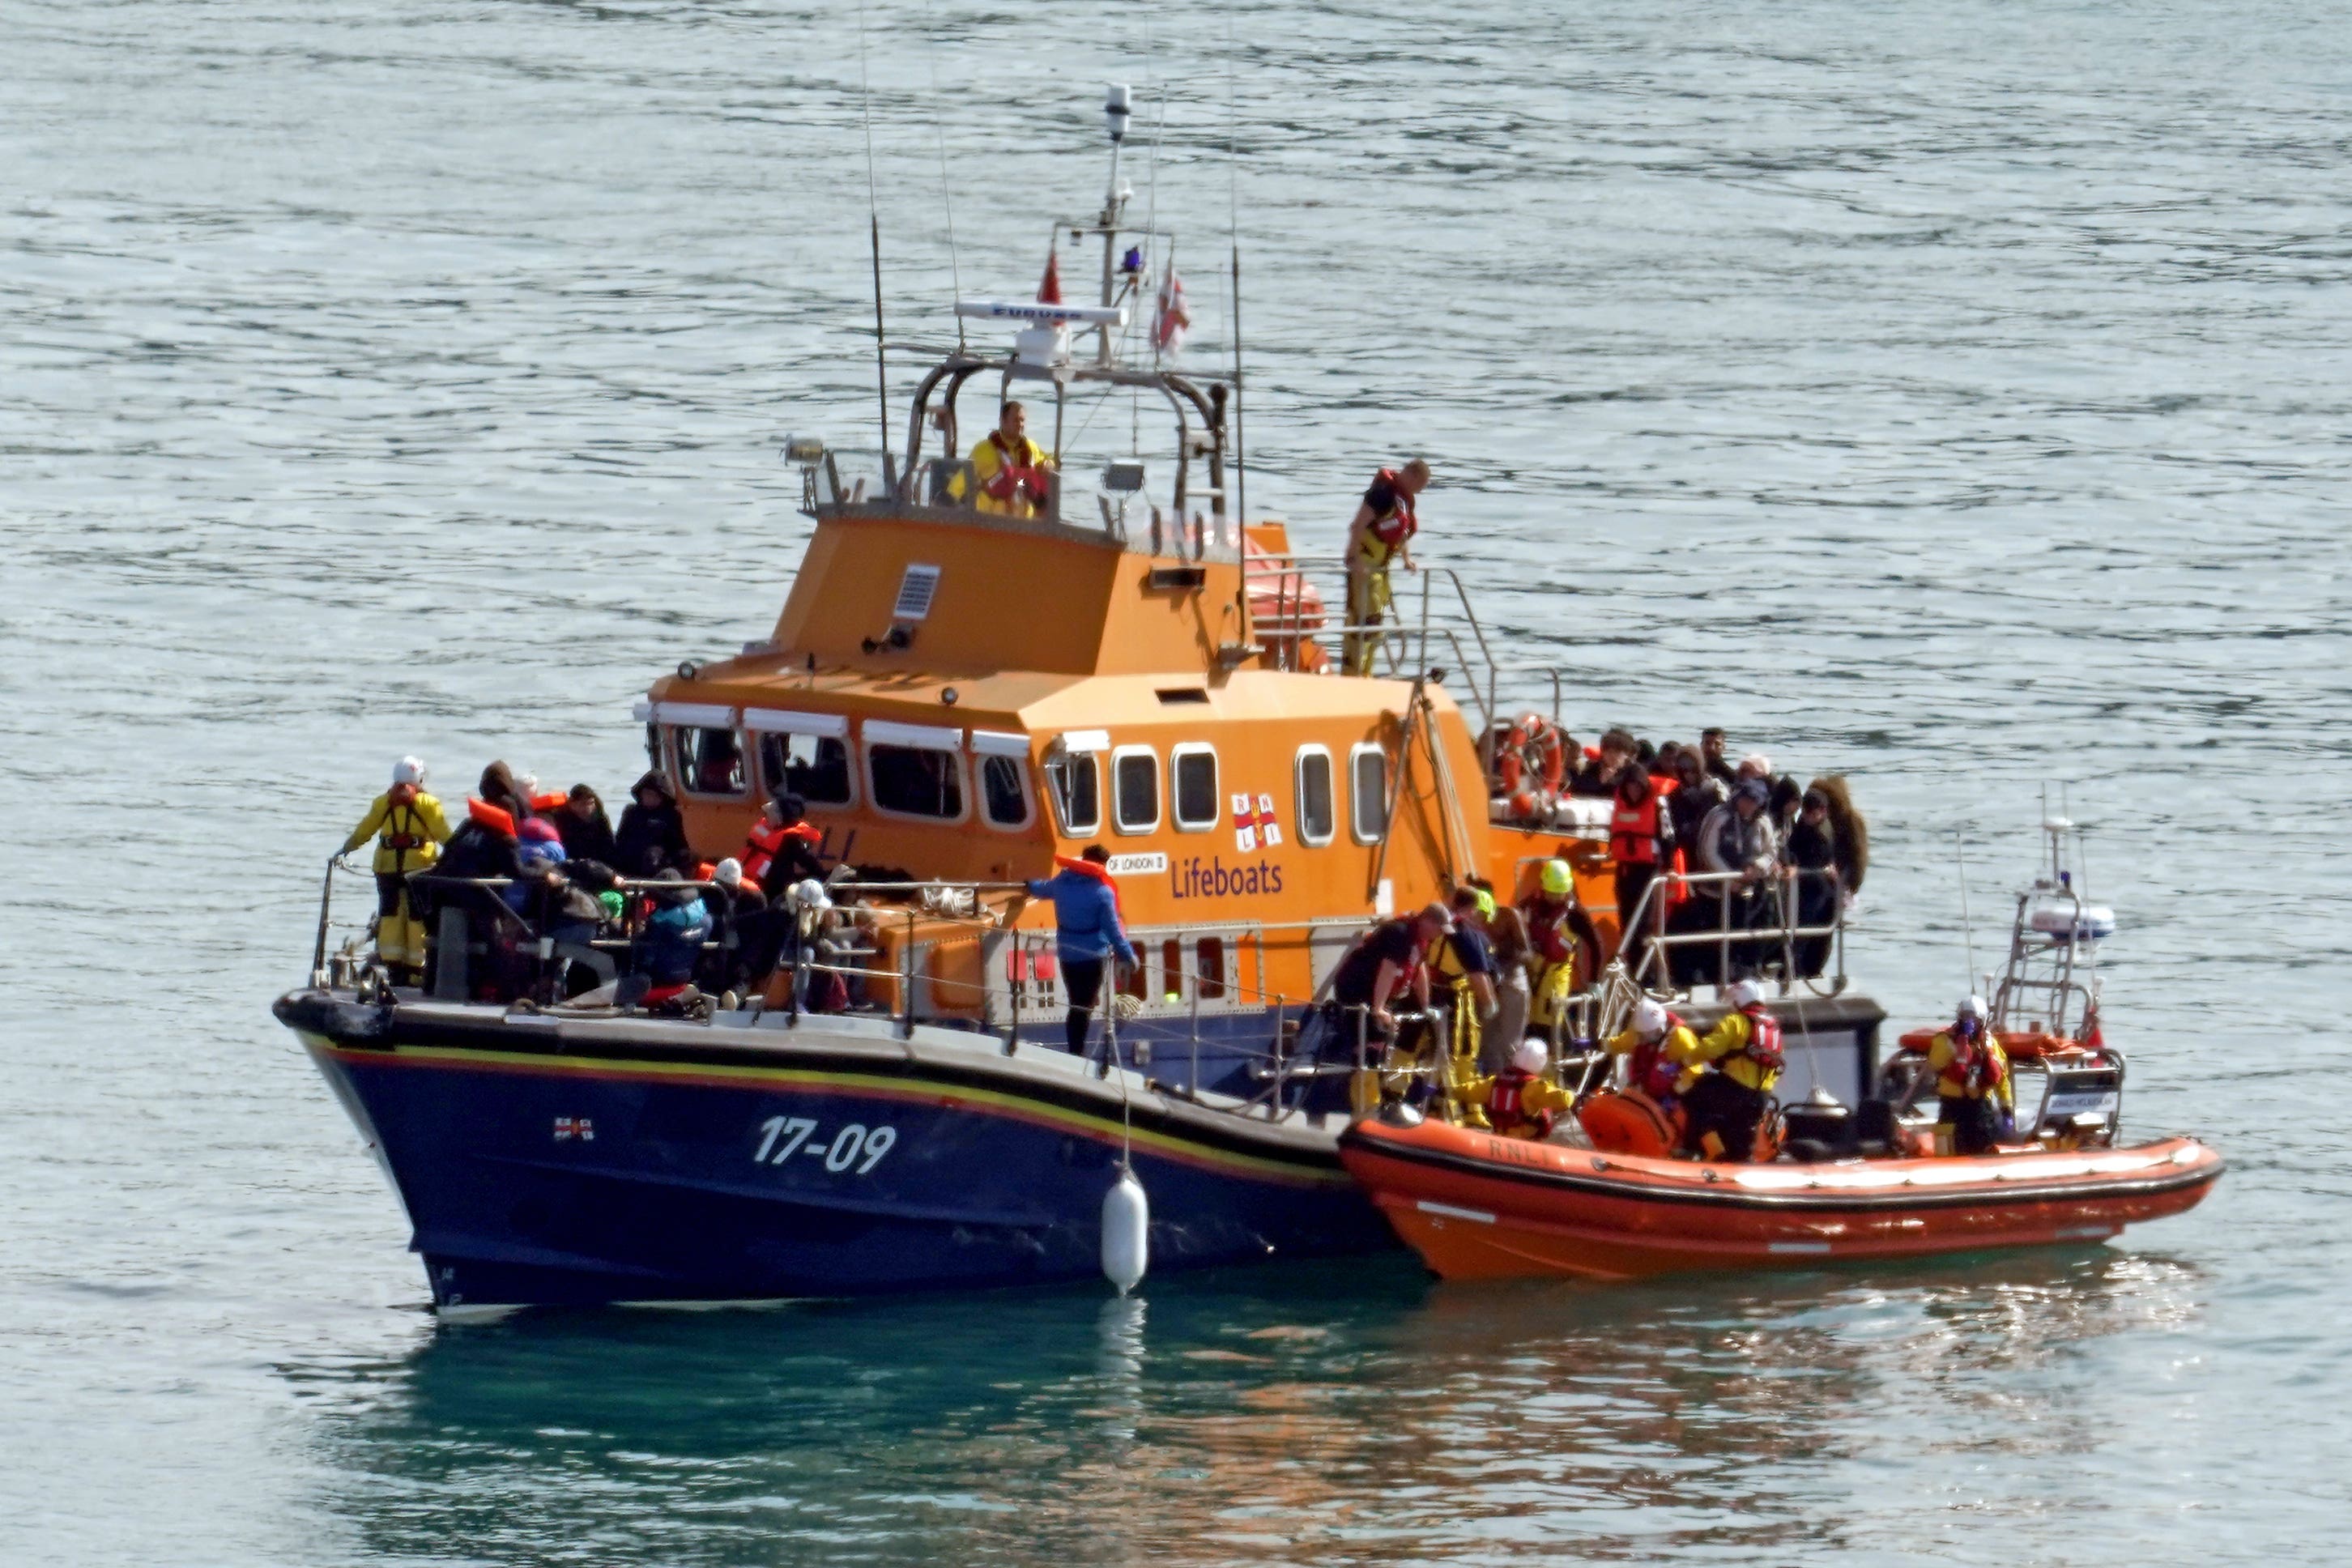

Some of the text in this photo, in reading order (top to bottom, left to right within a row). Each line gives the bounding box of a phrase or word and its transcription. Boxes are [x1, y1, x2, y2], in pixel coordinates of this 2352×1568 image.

[1122, 858, 1154, 870] LONDON
[1171, 855, 1282, 897] Lifeboats
[754, 1115, 897, 1174] 17-09
[1489, 1139, 1550, 1167] RNLI
